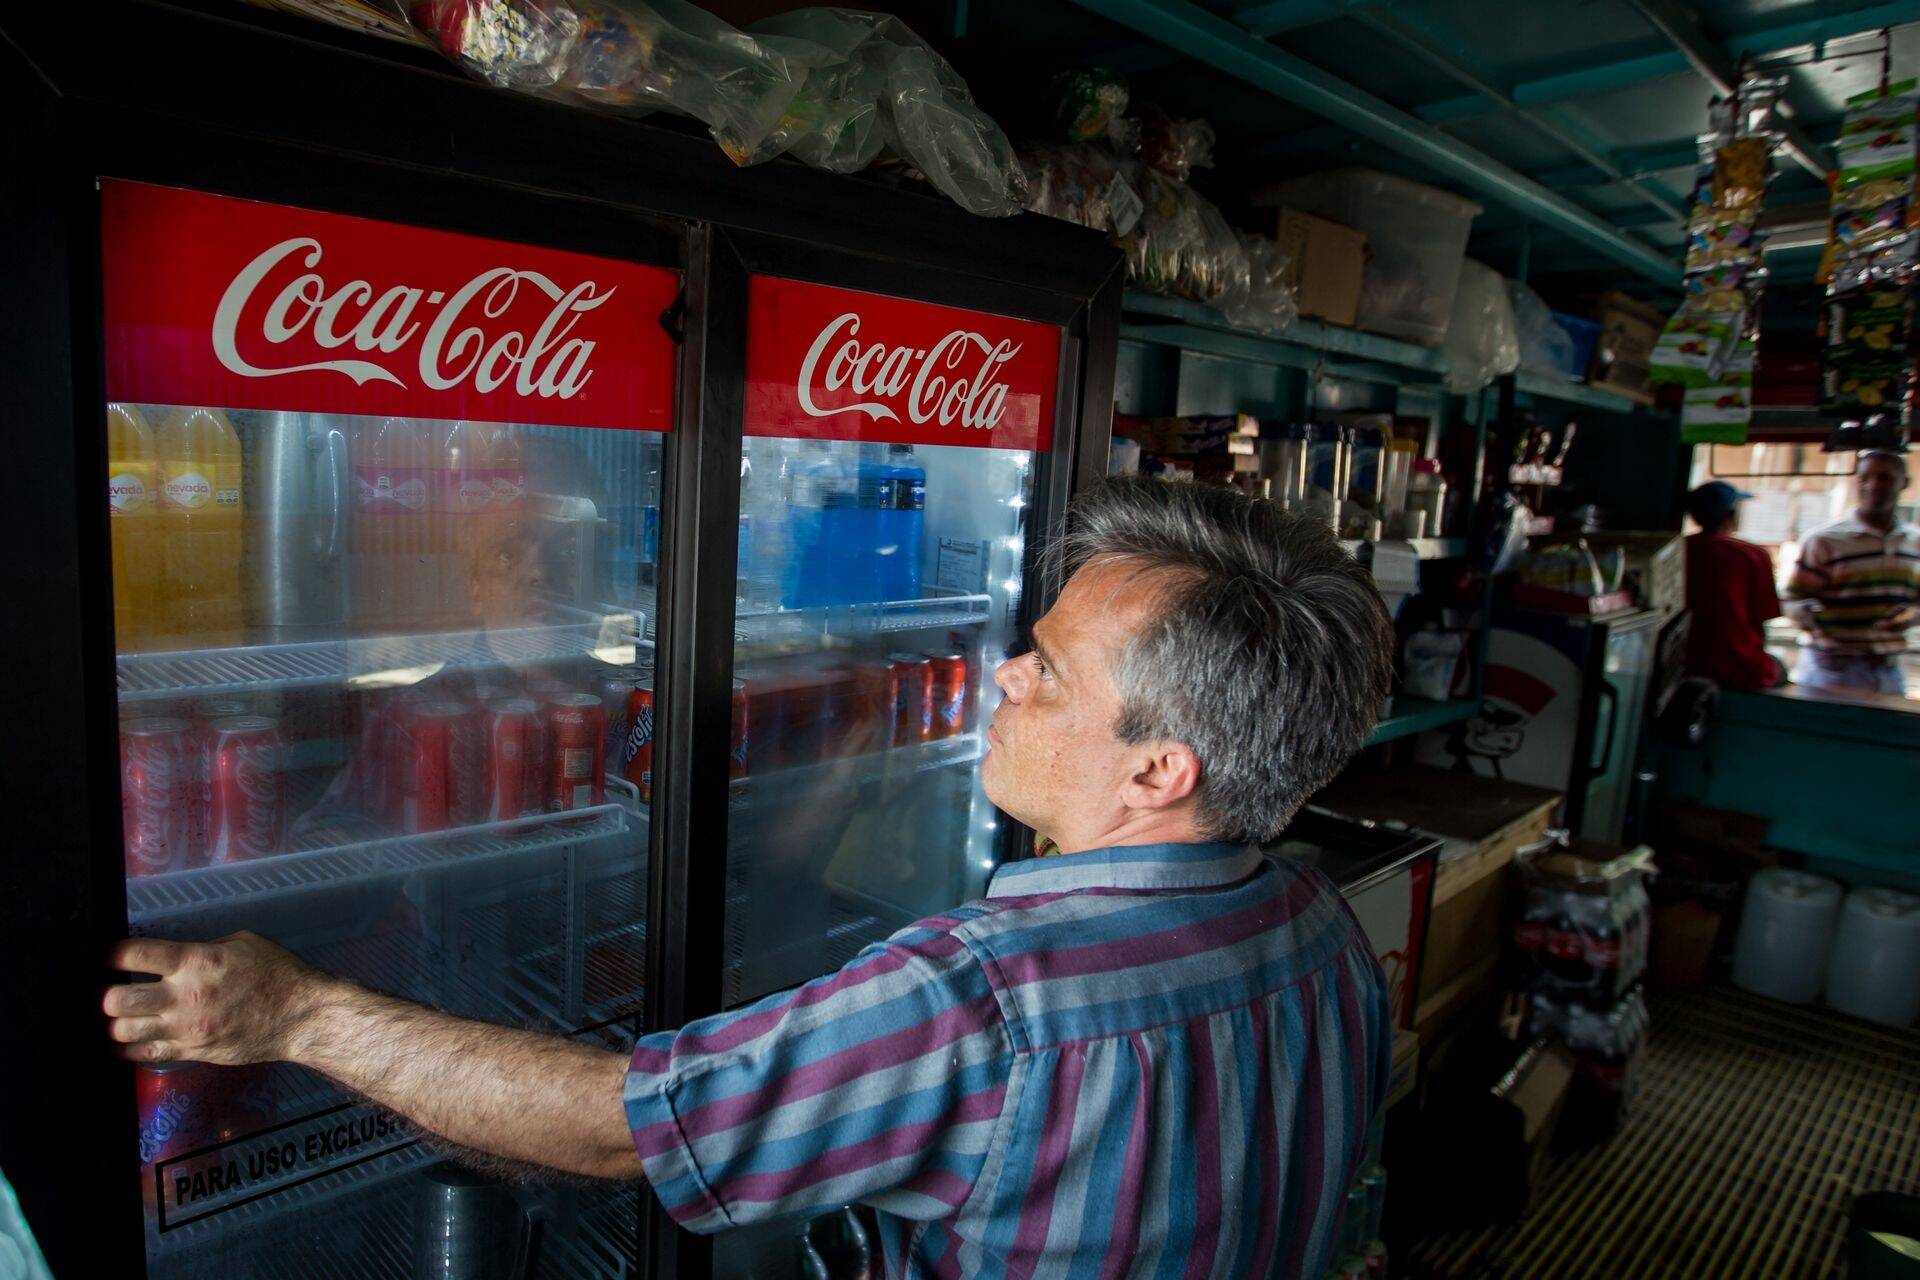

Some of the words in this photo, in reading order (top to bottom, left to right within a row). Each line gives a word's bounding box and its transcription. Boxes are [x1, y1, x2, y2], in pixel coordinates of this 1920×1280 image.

[212, 237, 618, 400] Coca-Cola
[797, 312, 1024, 430] Coca-Cola
[108, 484, 143, 495] evada
[166, 483, 209, 494] nevada
[175, 1160, 242, 1206] PARA
[249, 1141, 298, 1180] USO
